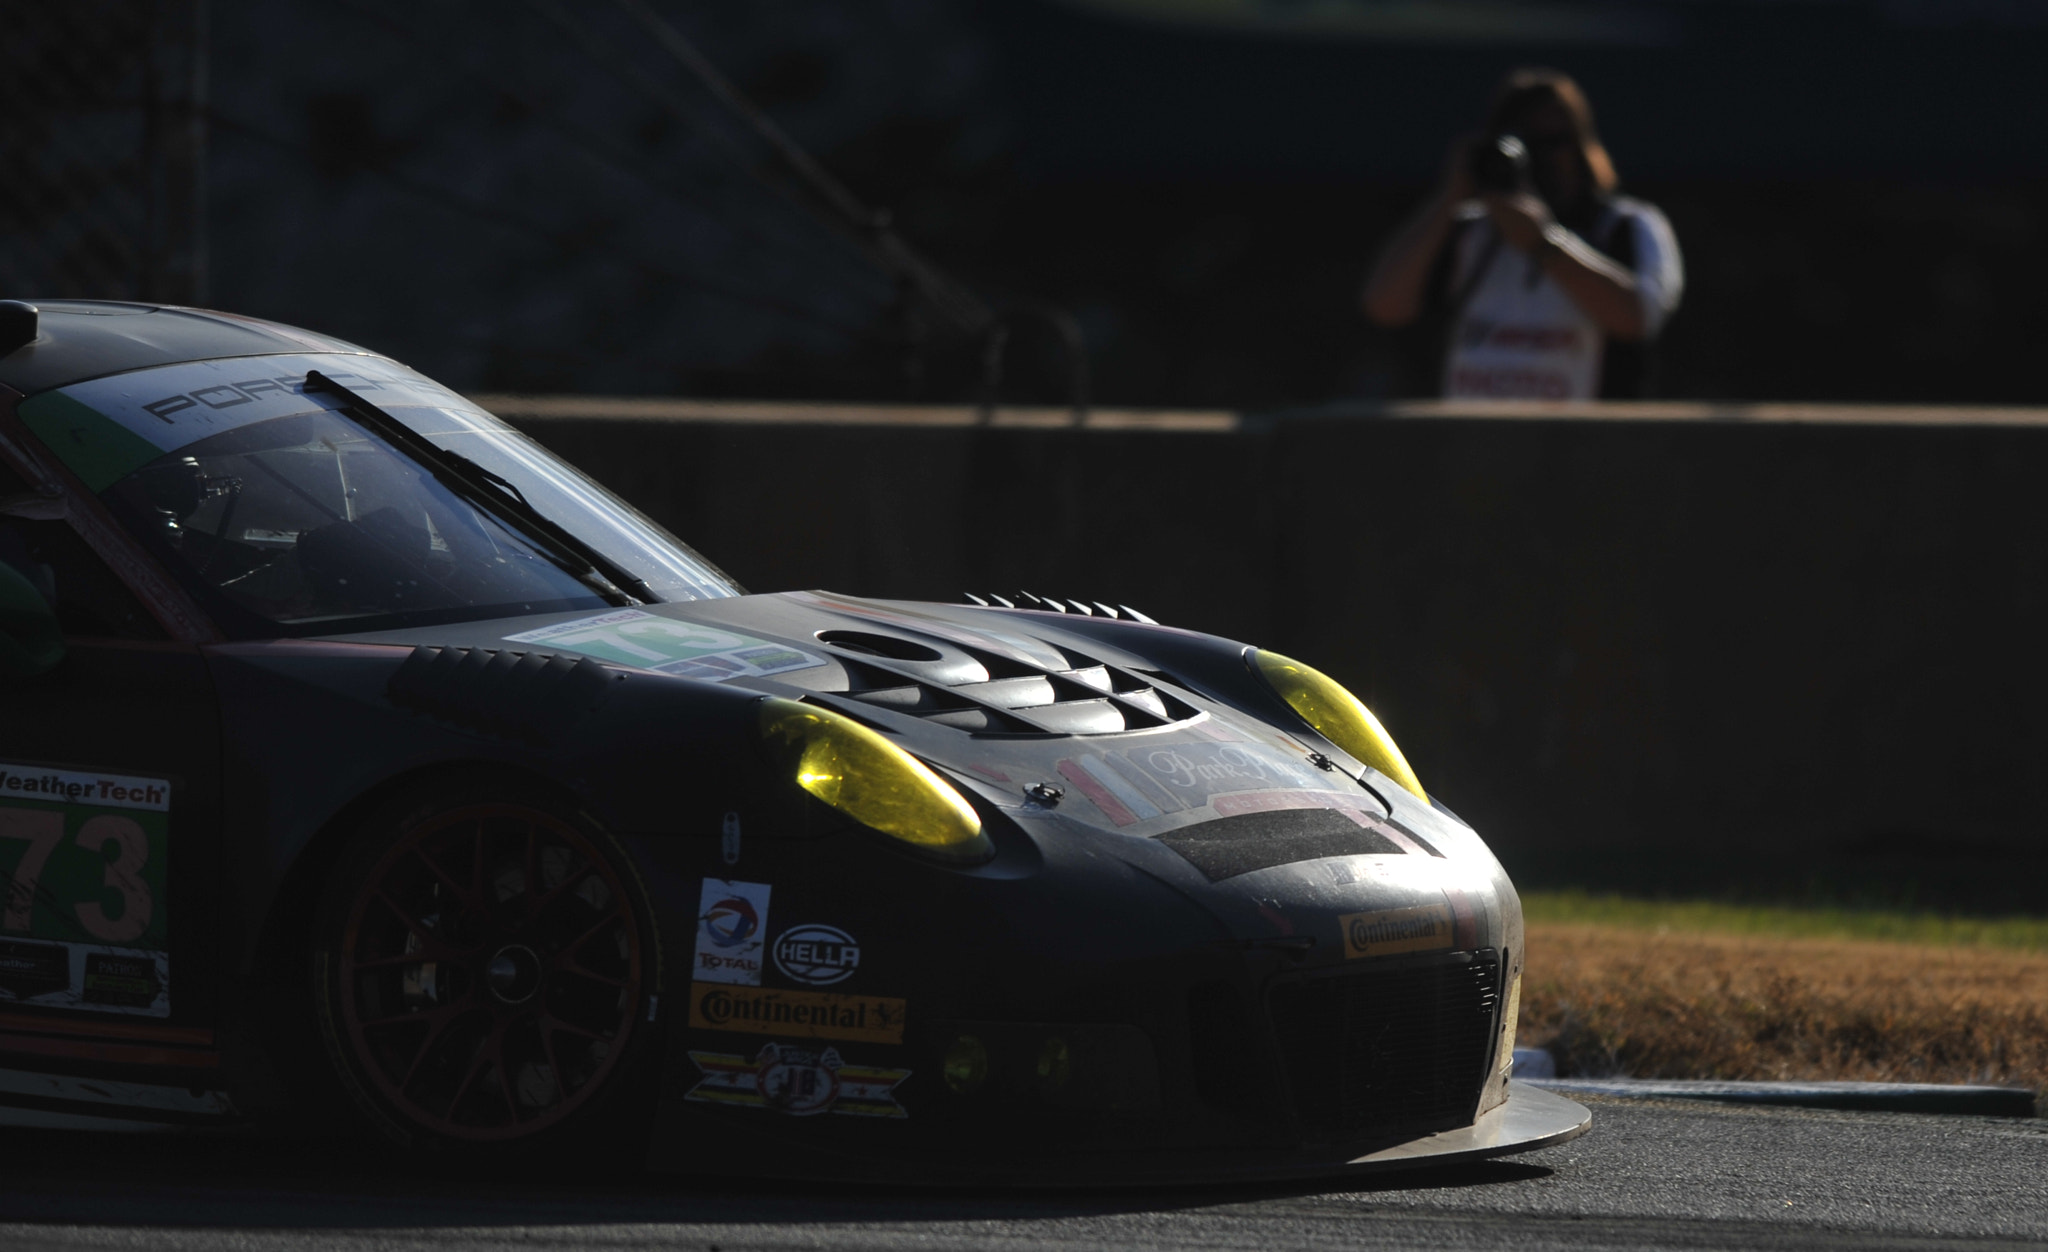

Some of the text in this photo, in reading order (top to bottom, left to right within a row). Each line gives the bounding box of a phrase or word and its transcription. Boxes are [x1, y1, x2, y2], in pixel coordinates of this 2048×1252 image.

[0, 806, 153, 943] 73
[1350, 911, 1435, 952] Continental
[781, 942, 860, 968] HELLA
[701, 990, 865, 1029] Continental
